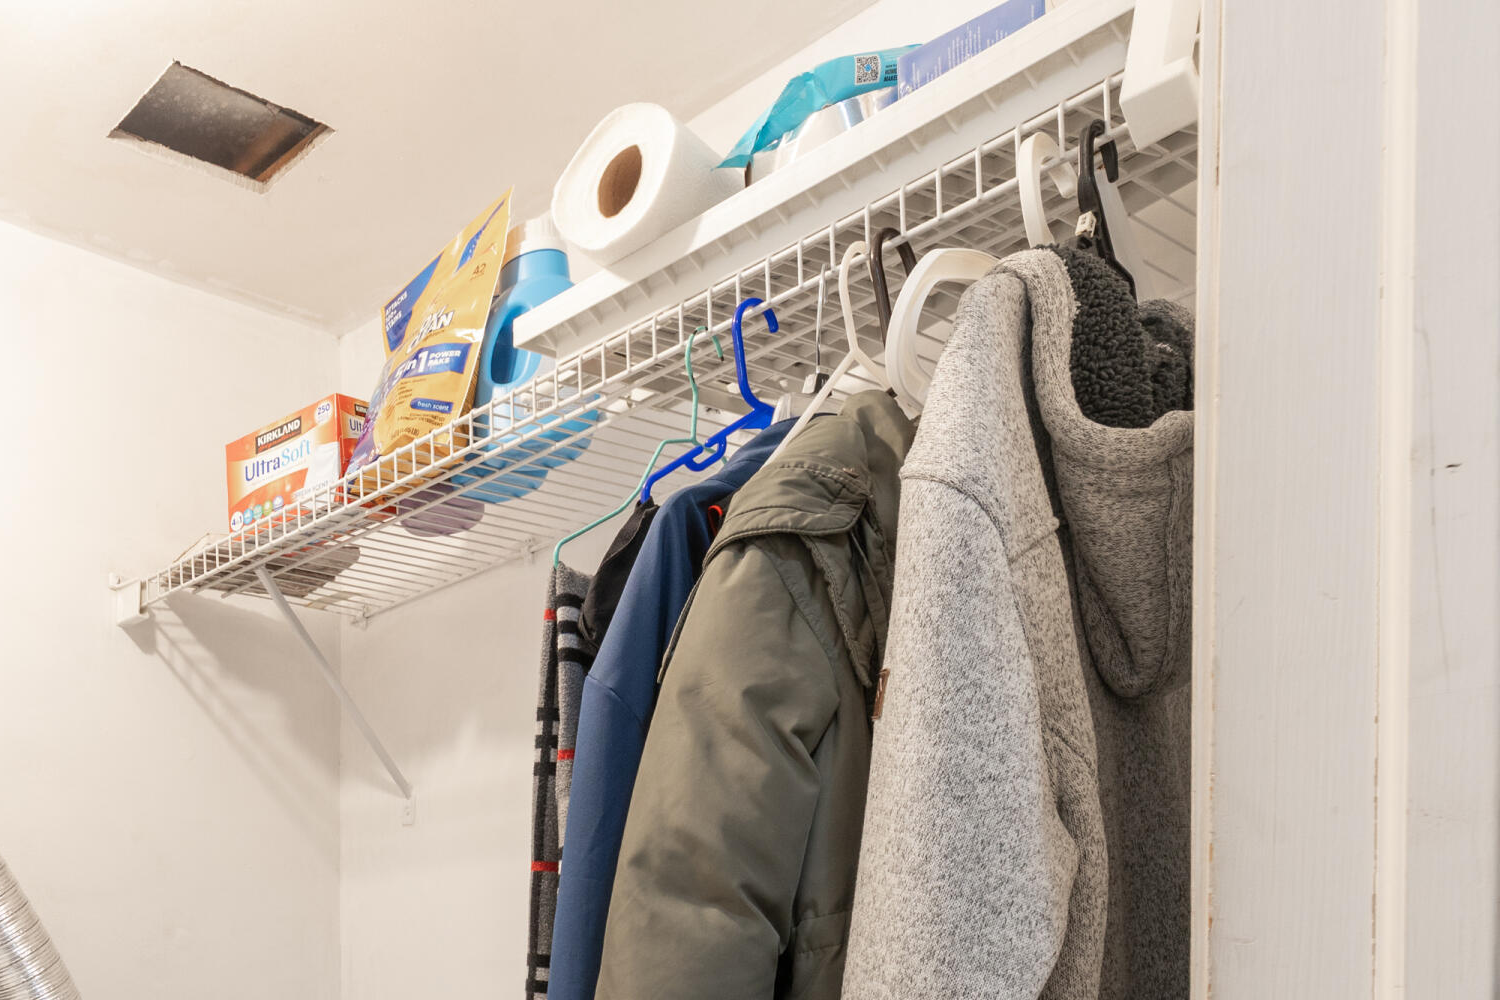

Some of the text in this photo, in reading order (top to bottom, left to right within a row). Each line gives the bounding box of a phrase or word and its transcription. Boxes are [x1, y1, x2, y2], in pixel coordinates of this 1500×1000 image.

[430, 350, 461, 360] POWER
[317, 403, 331, 415] 250
[417, 401, 432, 409] fresh
[257, 419, 301, 447] KIRKLAND
[245, 439, 311, 482] UltraSoft
